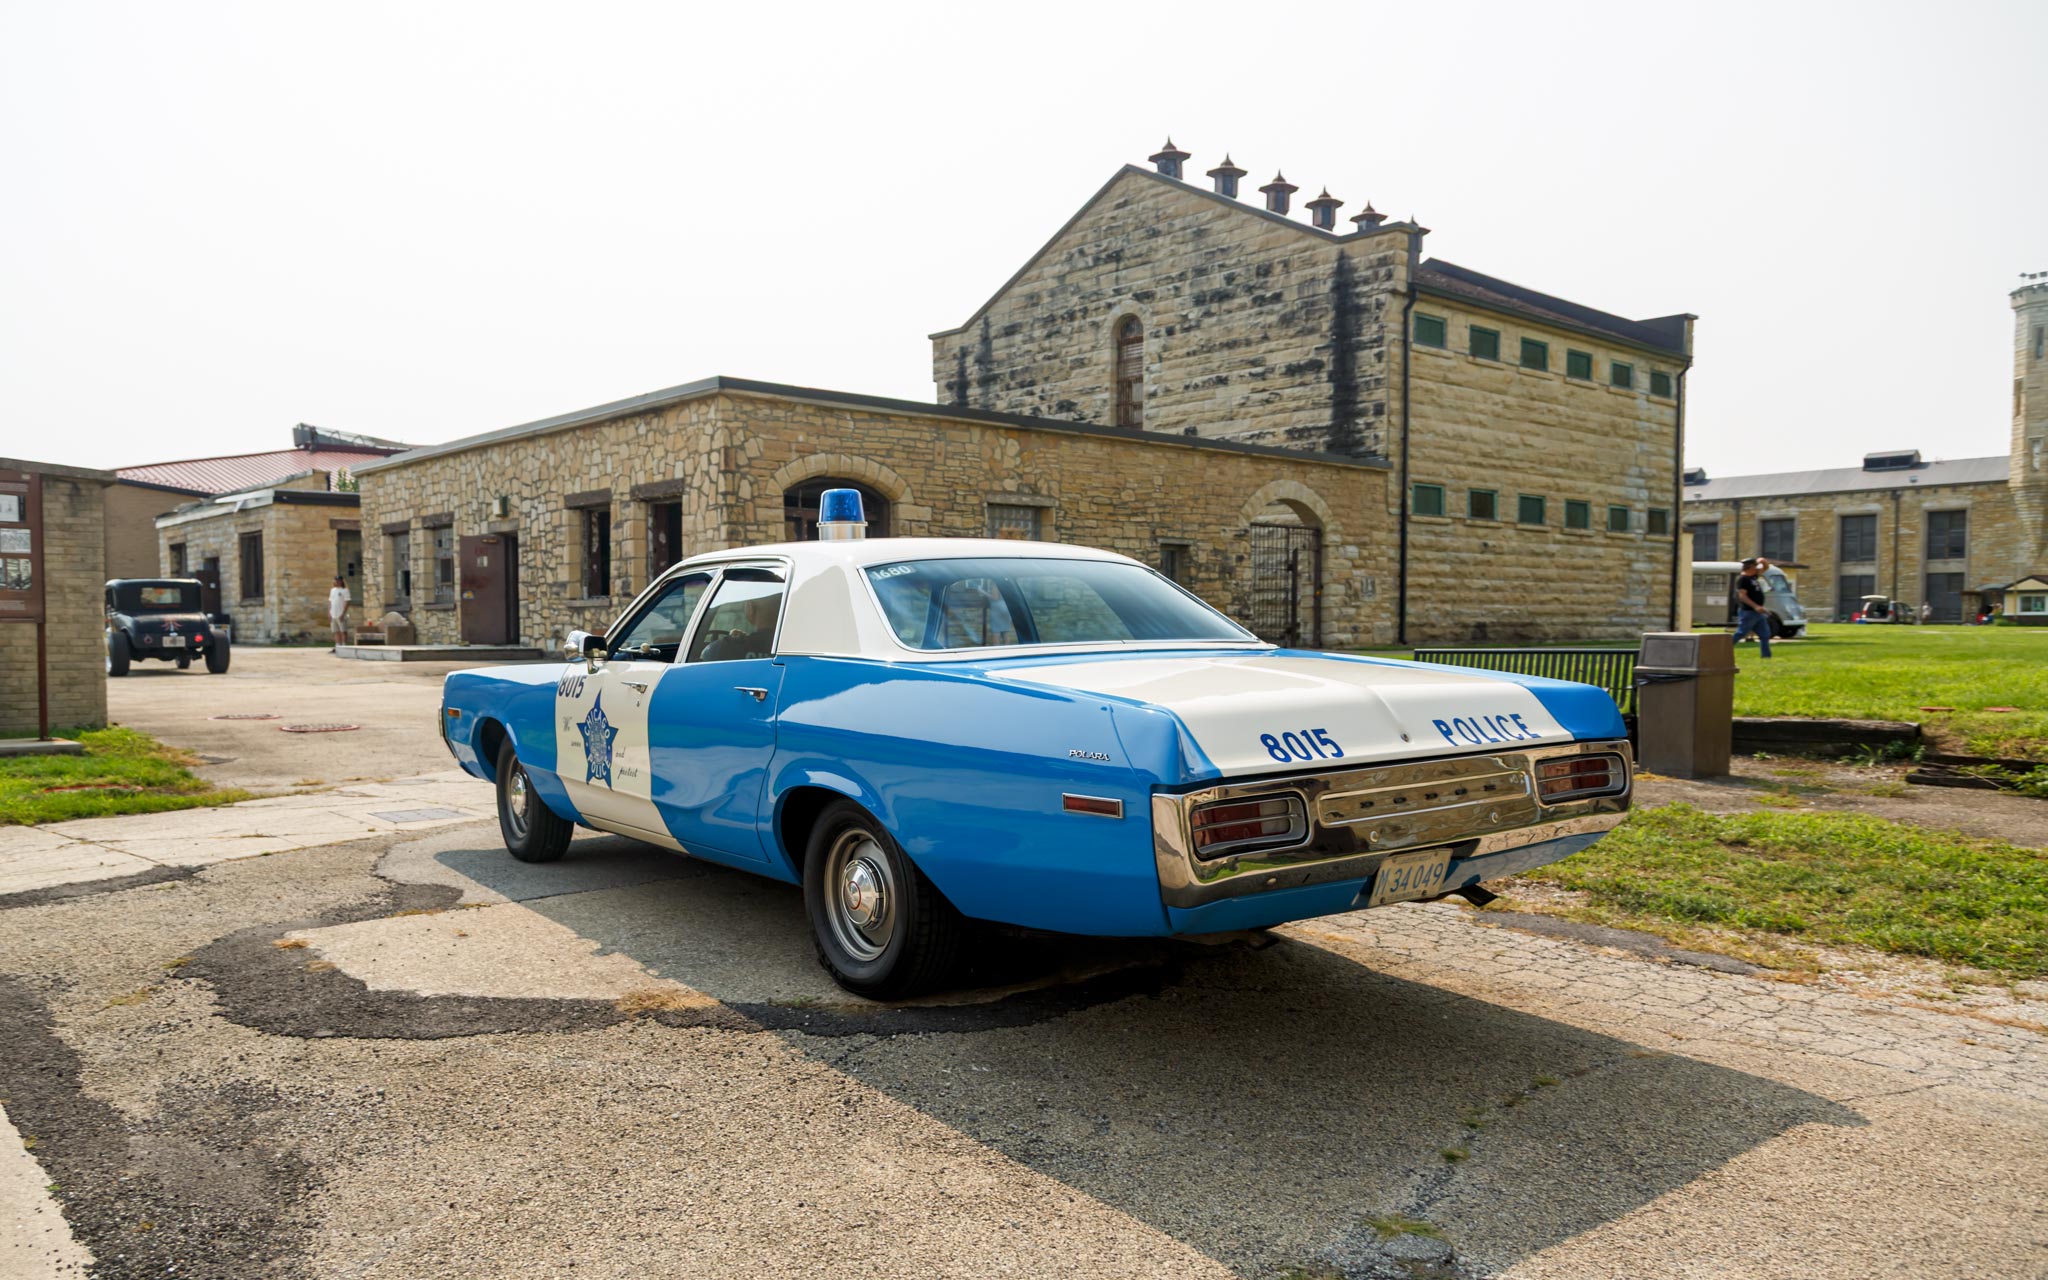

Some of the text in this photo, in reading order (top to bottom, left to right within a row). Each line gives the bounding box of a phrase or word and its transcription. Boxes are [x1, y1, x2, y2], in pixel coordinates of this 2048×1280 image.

[872, 565, 911, 580] 1680
[559, 676, 586, 698] 8015
[584, 708, 610, 738] CHICAGO
[1260, 713, 1541, 763] 8015 POLICE
[588, 754, 611, 778] POLICE
[1069, 749, 1110, 761] POLARA
